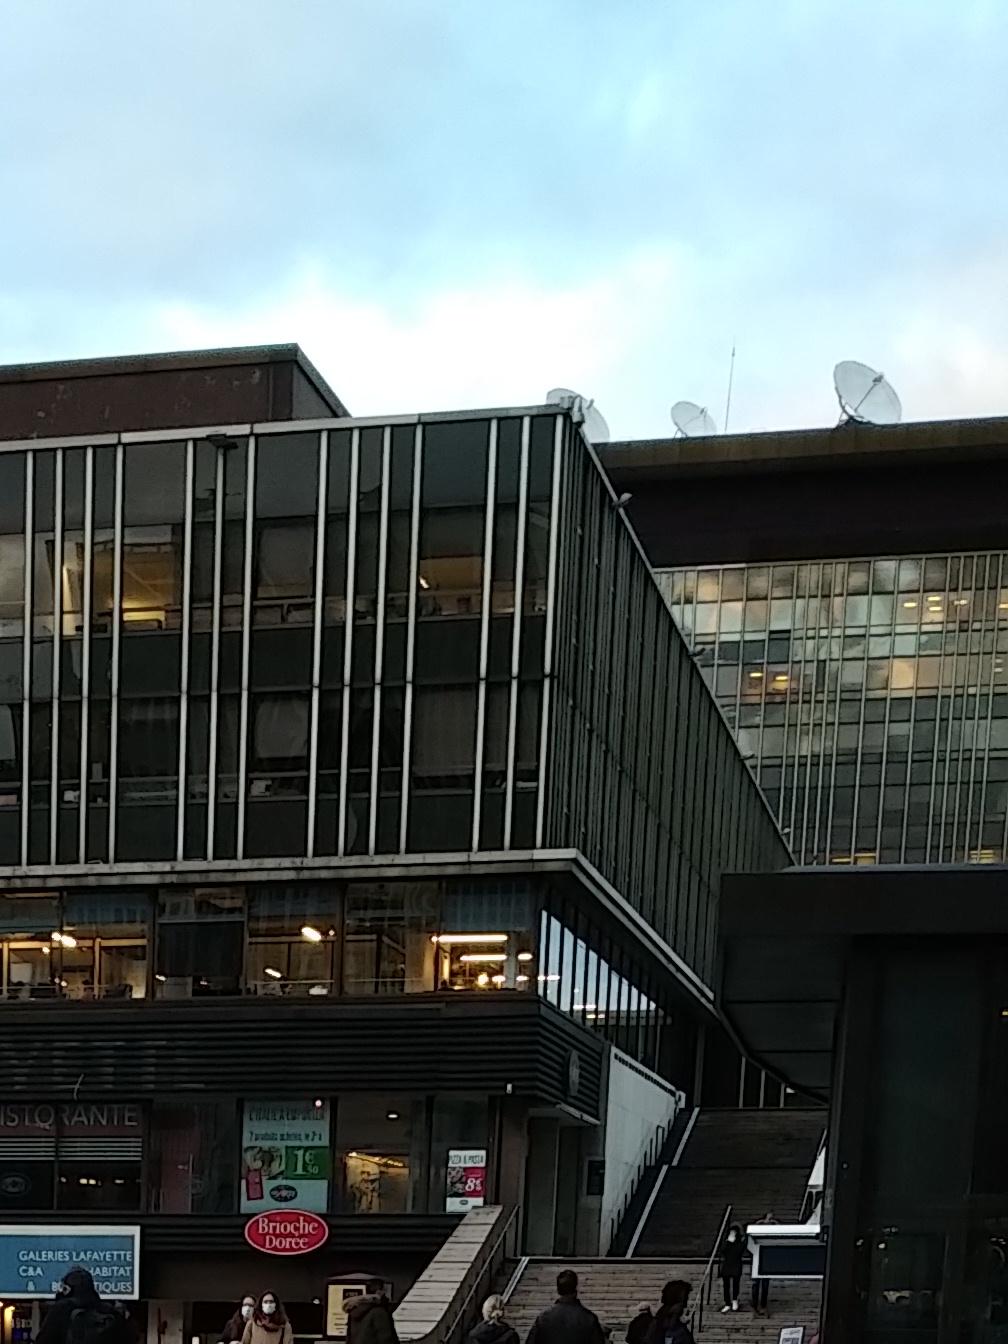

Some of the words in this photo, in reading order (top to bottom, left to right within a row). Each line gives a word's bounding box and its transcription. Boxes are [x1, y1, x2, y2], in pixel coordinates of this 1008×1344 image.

[258, 1216, 319, 1237] Brioche
[18, 1250, 69, 1262] GALERIES
[72, 1250, 132, 1262] LAFAYETTE
[18, 1265, 44, 1277] C&A
[27, 1280, 35, 1292] &
